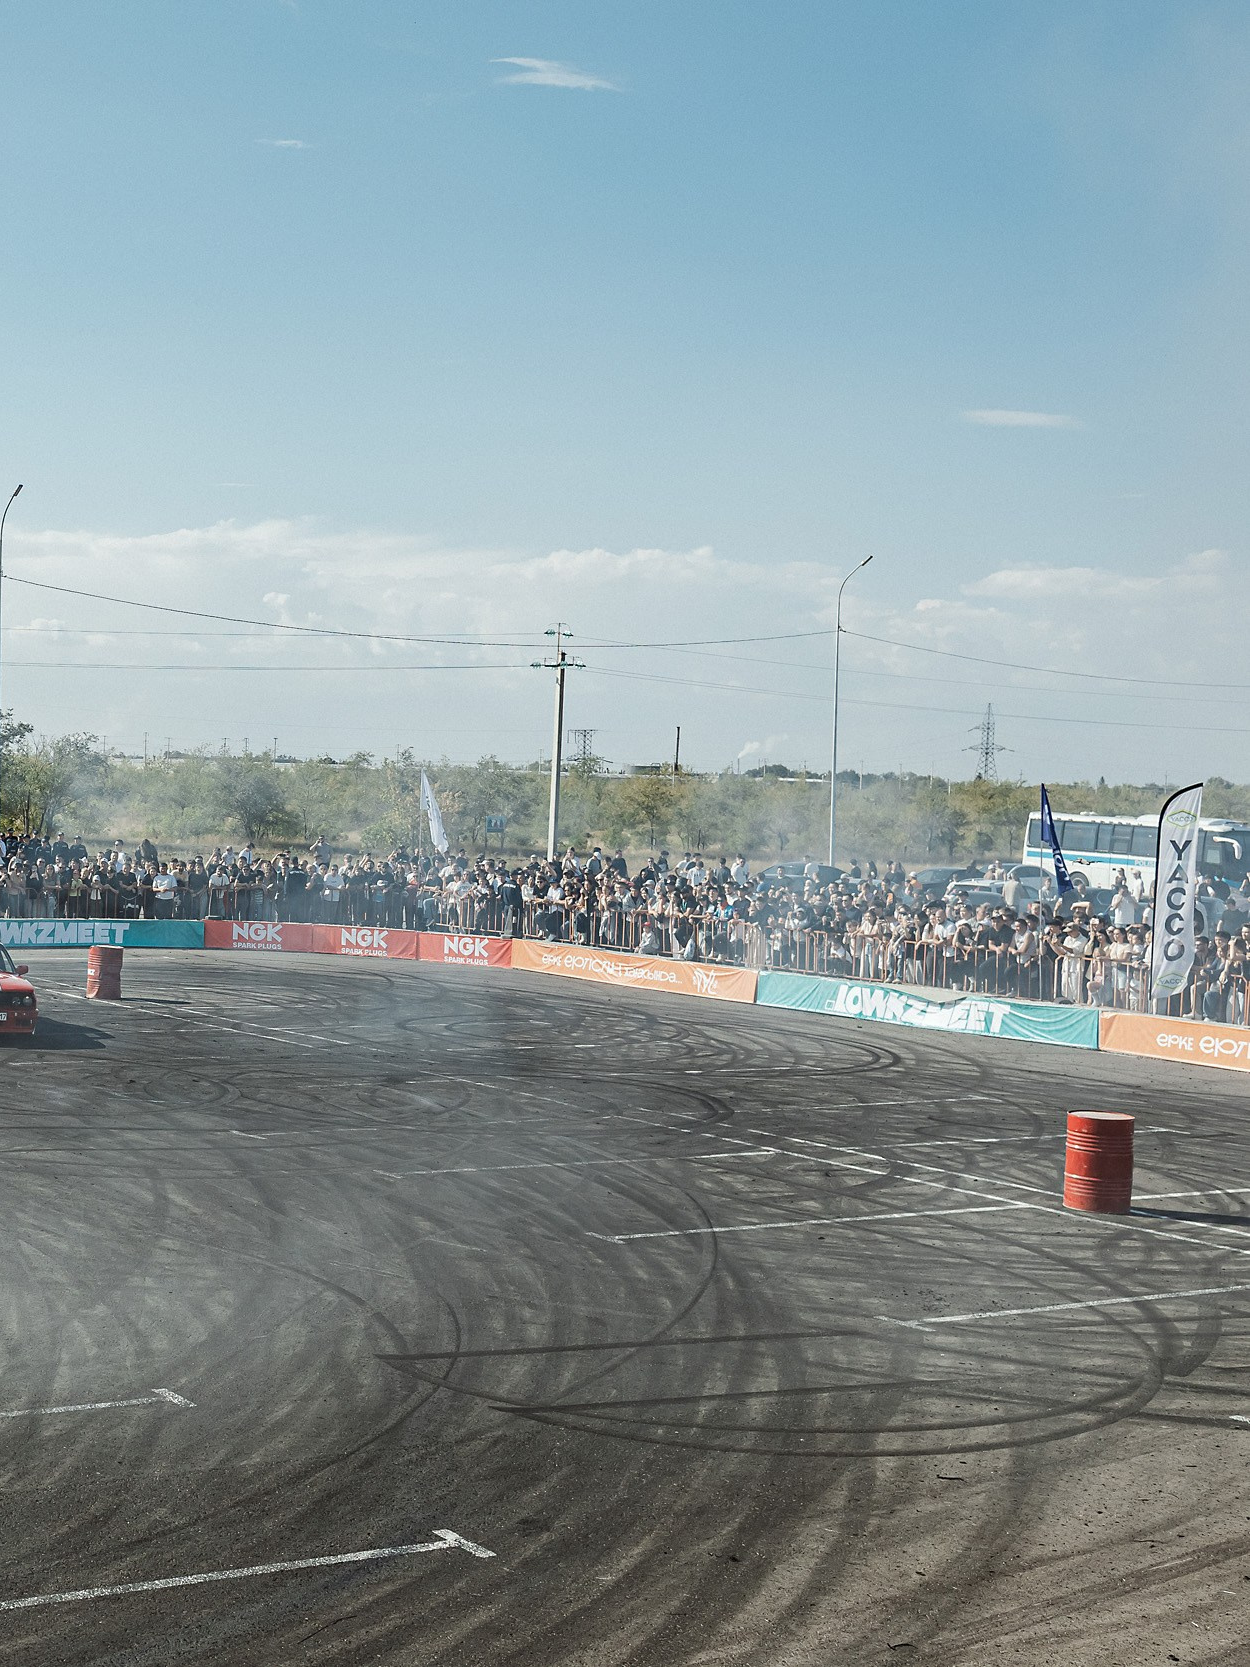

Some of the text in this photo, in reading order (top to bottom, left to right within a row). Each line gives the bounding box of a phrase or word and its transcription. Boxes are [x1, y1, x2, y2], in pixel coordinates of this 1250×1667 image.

[1163, 839, 1192, 962] YACCO
[232, 923, 282, 942] NGK
[341, 928, 389, 949] NGK
[341, 948, 363, 956] SPARK
[443, 935, 489, 957] NGK
[443, 956, 489, 966] SPARK PLUGS
